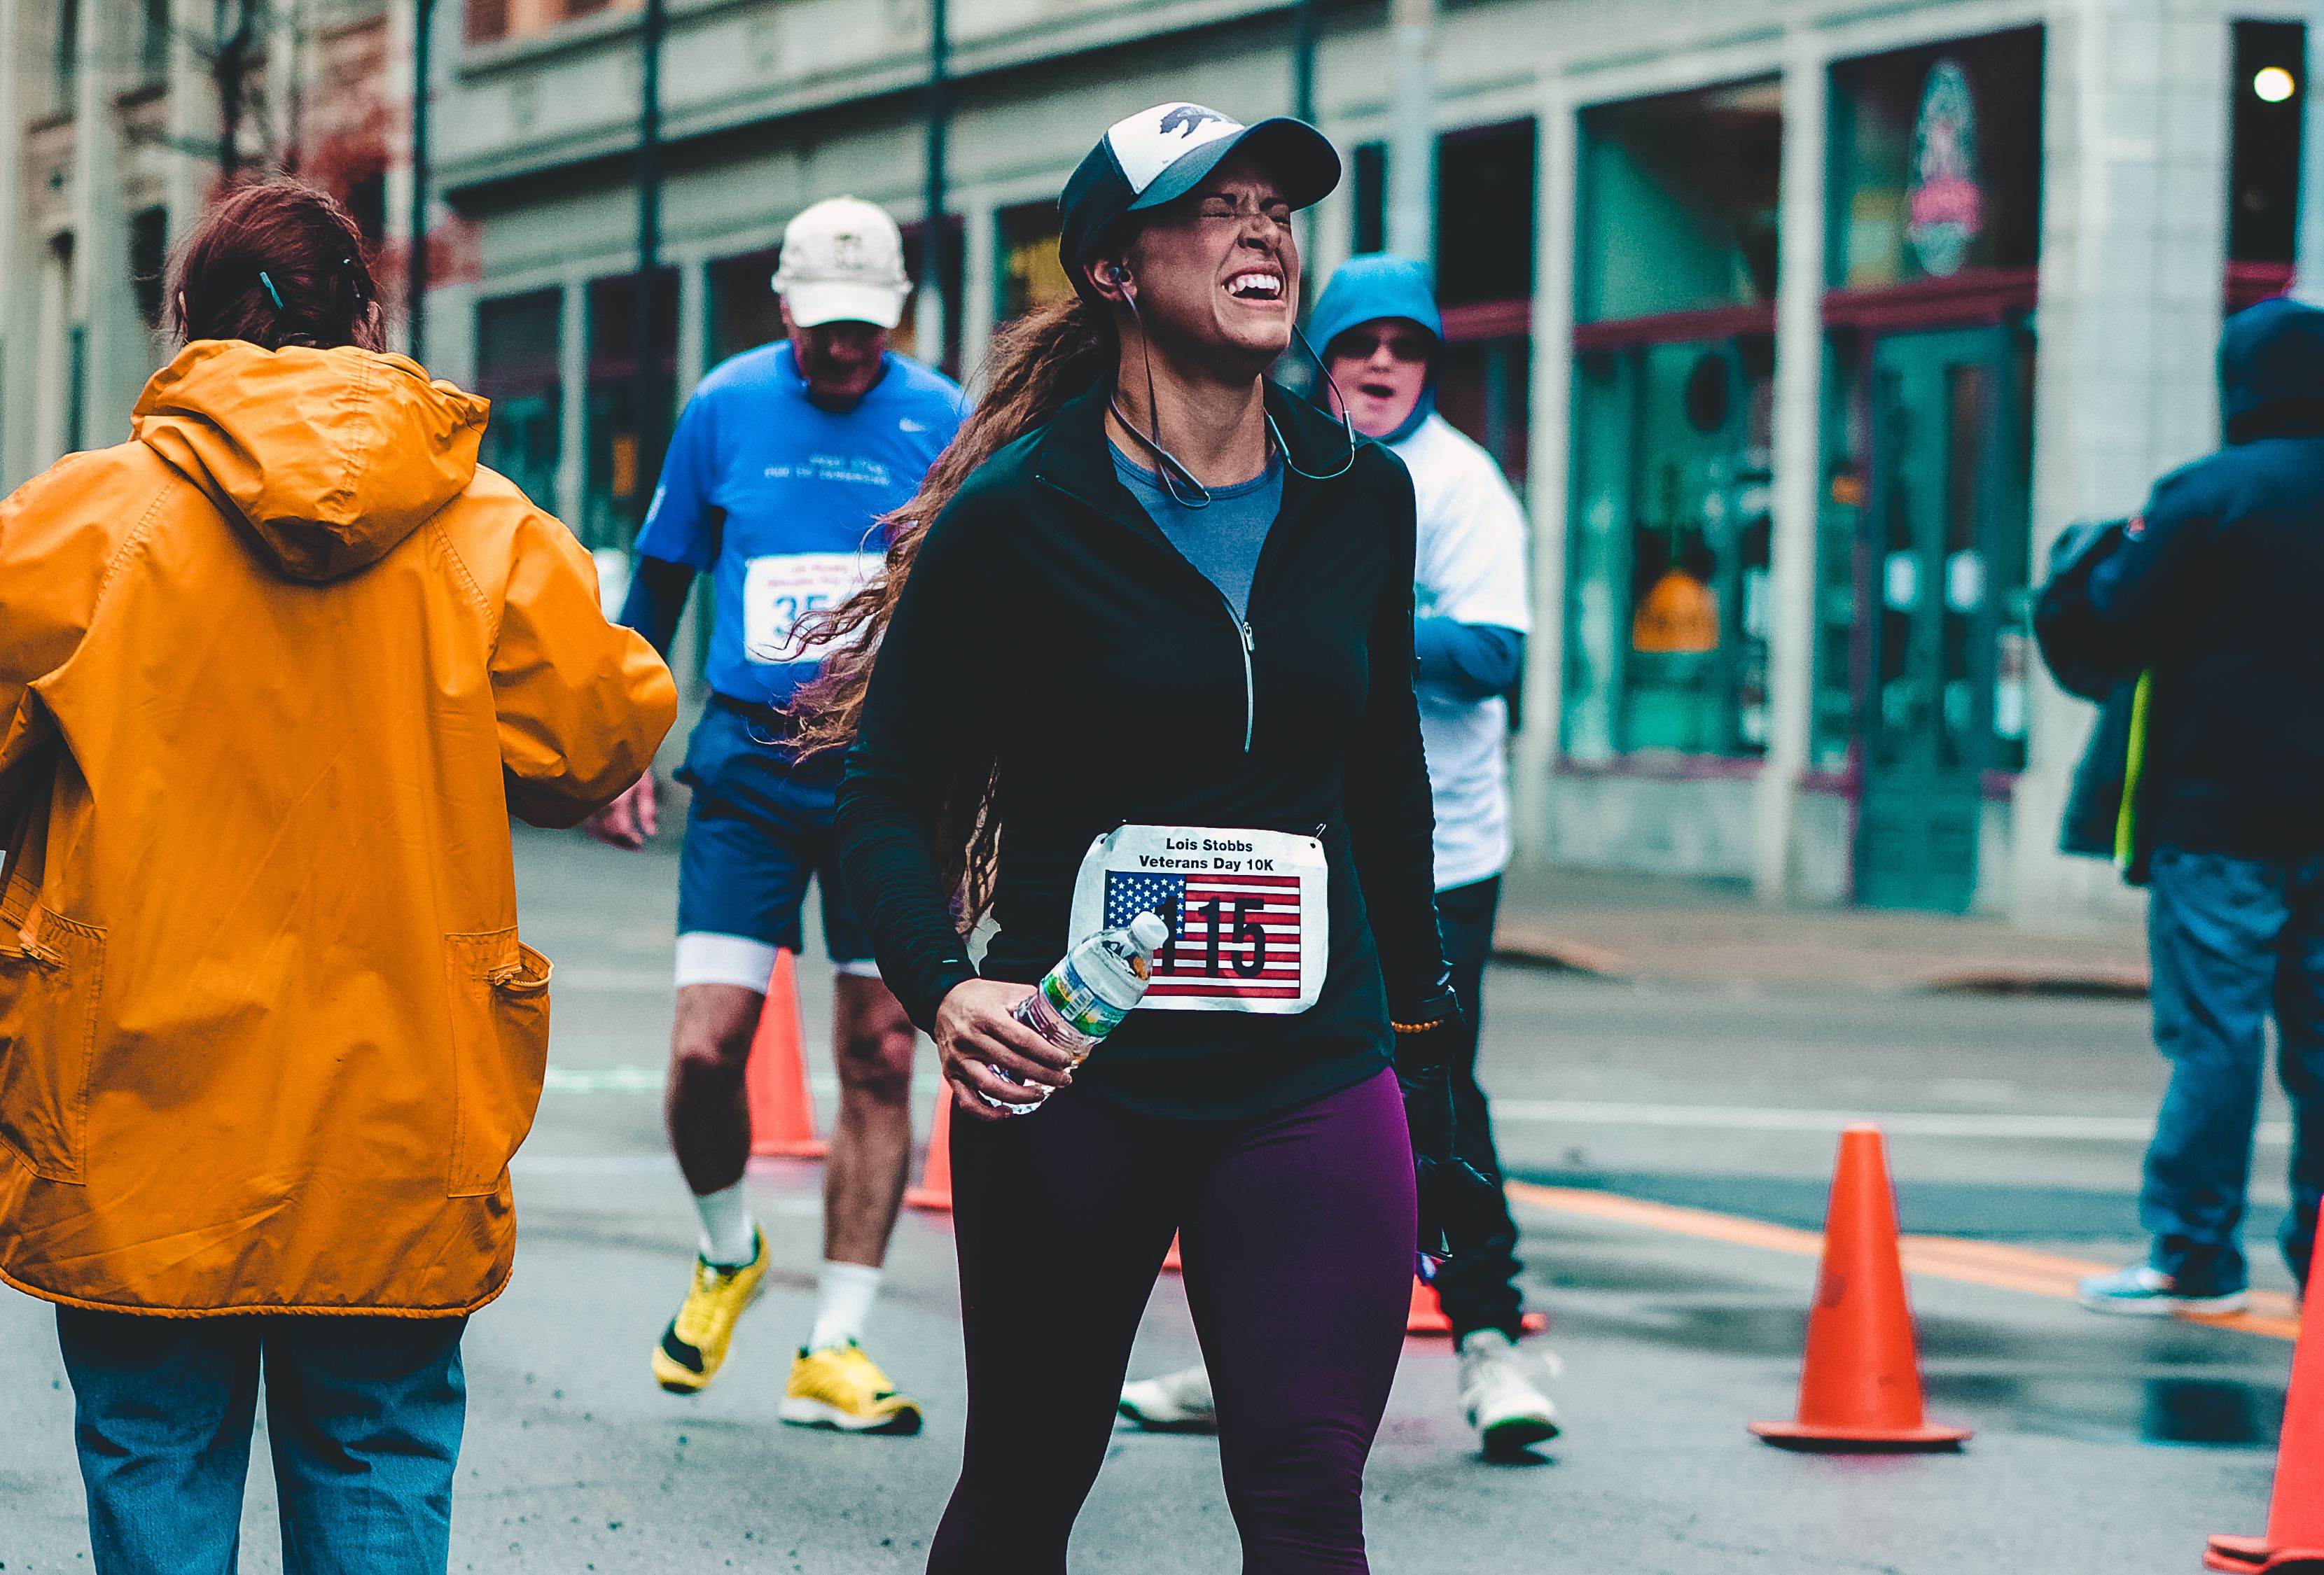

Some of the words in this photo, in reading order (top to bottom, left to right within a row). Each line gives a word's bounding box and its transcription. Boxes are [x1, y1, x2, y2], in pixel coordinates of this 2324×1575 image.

[1166, 838, 1197, 850] Lois
[1202, 839, 1253, 852] Stobbs
[1139, 855, 1208, 869] Veterans
[1213, 858, 1241, 872] Day
[1247, 859, 1274, 872] 10K
[1155, 896, 1265, 977] 115
